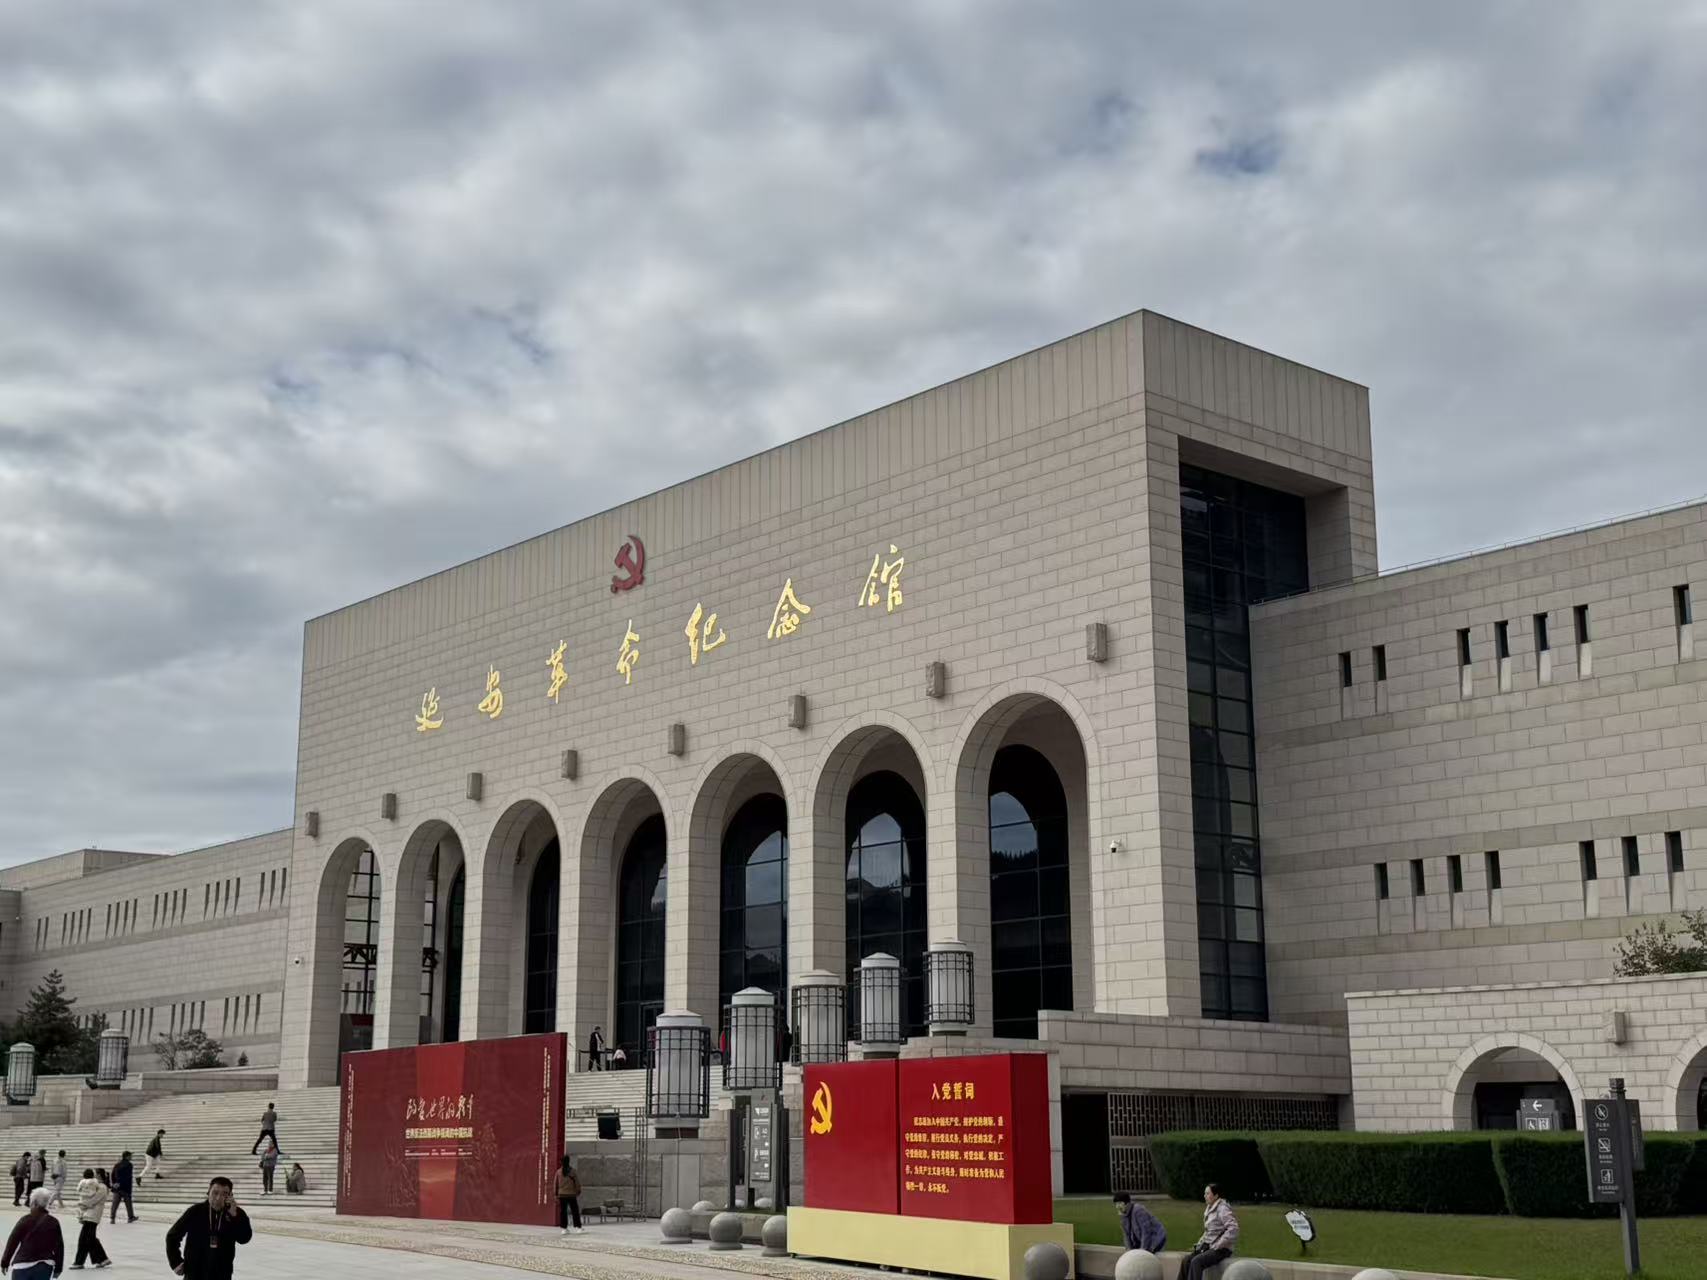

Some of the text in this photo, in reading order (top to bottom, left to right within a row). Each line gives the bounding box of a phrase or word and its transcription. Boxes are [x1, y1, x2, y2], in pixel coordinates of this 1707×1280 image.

[415, 544, 905, 732] 延安革命纪念馆
[931, 1082, 975, 1100] 入党誓词
[913, 1116, 1004, 1127] 志入中共产党，护党，
[905, 1133, 1004, 1144] 守，行党员义务，行党决定，严
[905, 1165, 1005, 1178] ，共产主义斗，时备为党人民
[905, 1181, 950, 1193] 一，永不党。
